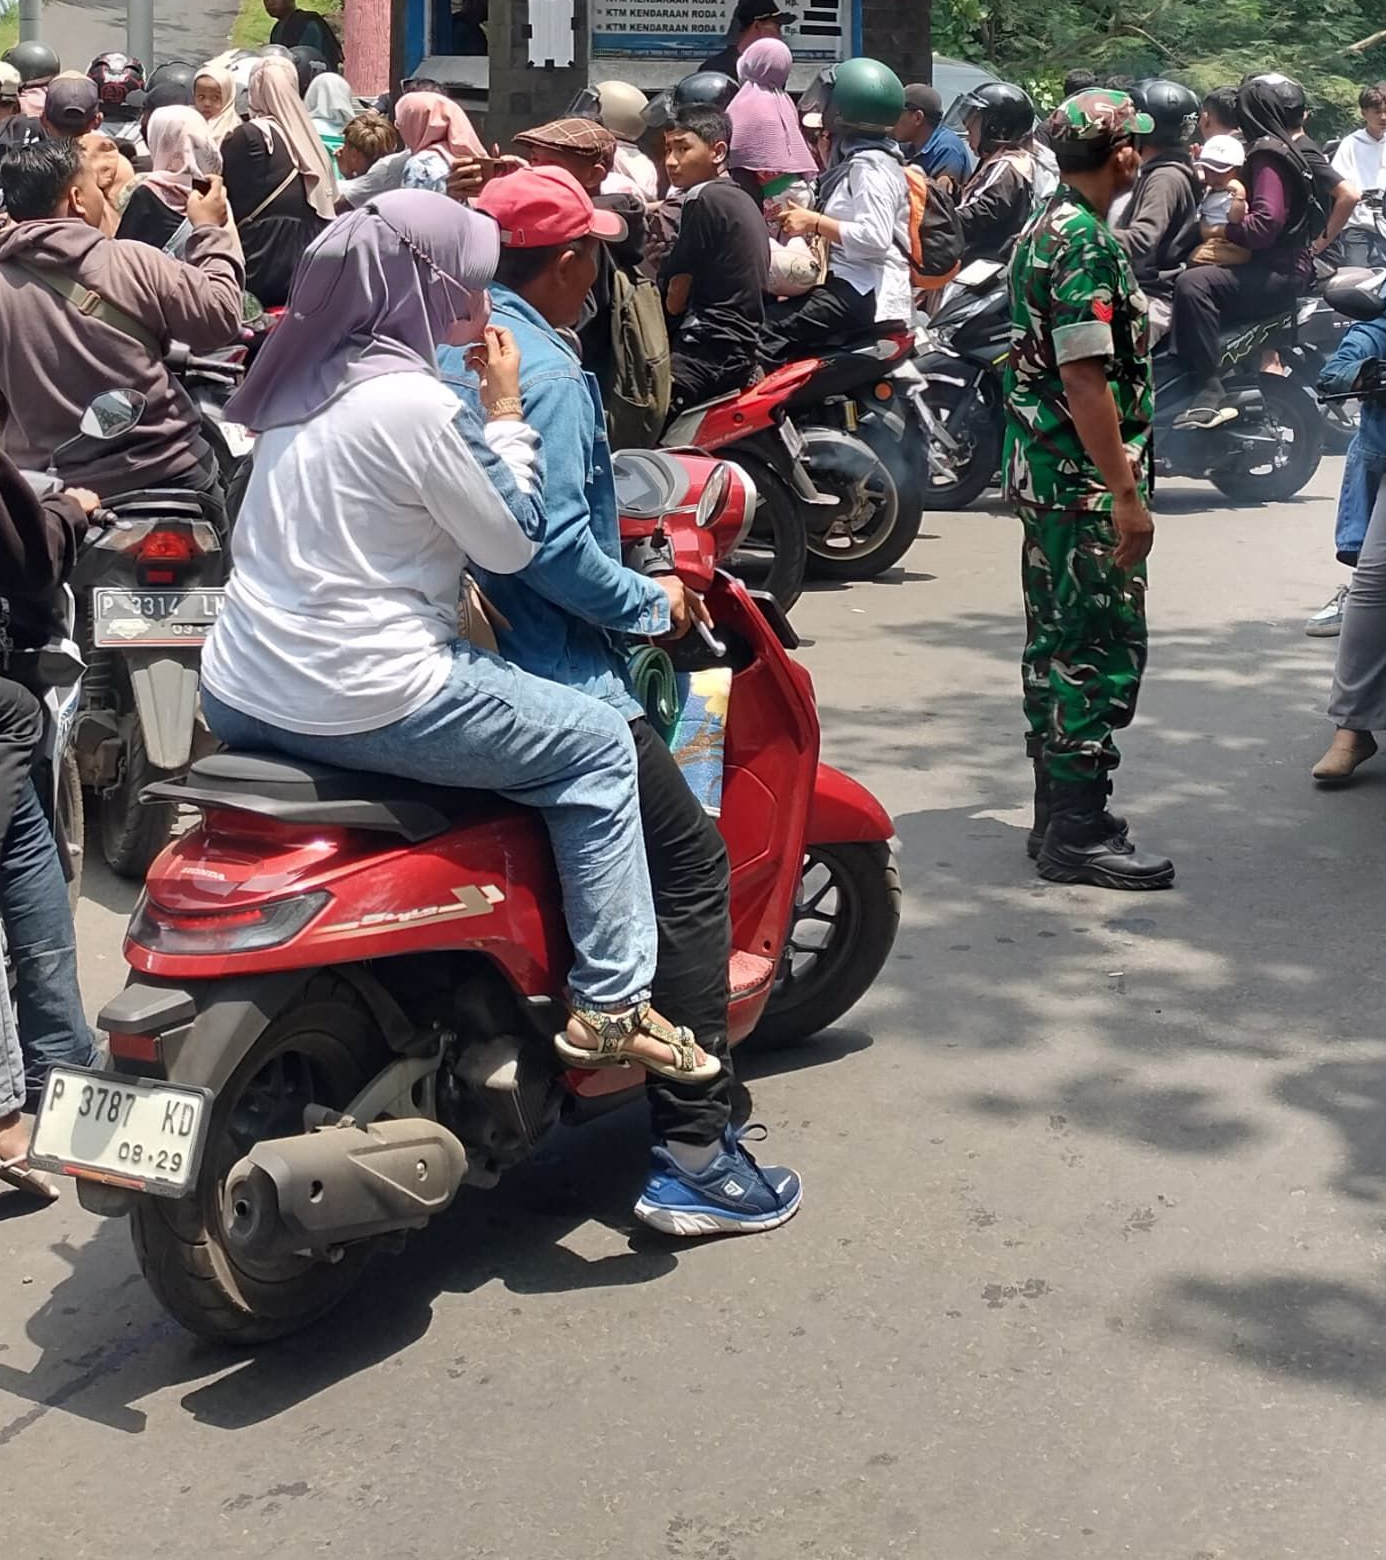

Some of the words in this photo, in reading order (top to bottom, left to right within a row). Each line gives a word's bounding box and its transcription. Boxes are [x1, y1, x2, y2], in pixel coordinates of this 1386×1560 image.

[606, 8, 628, 17] KTM
[629, 8, 690, 18] KENDARAAN
[692, 9, 718, 18] RODA
[719, 9, 726, 18] 4
[606, 23, 628, 32] KTM
[629, 23, 690, 33] KENDARAAN
[692, 24, 718, 33] RODA
[785, 26, 800, 36] Rp.
[102, 596, 114, 615] P
[131, 596, 180, 615] 3314
[180, 866, 226, 881] HONDA
[49, 1078, 65, 1112] P
[78, 1085, 137, 1128] 3787
[161, 1099, 196, 1137] KD
